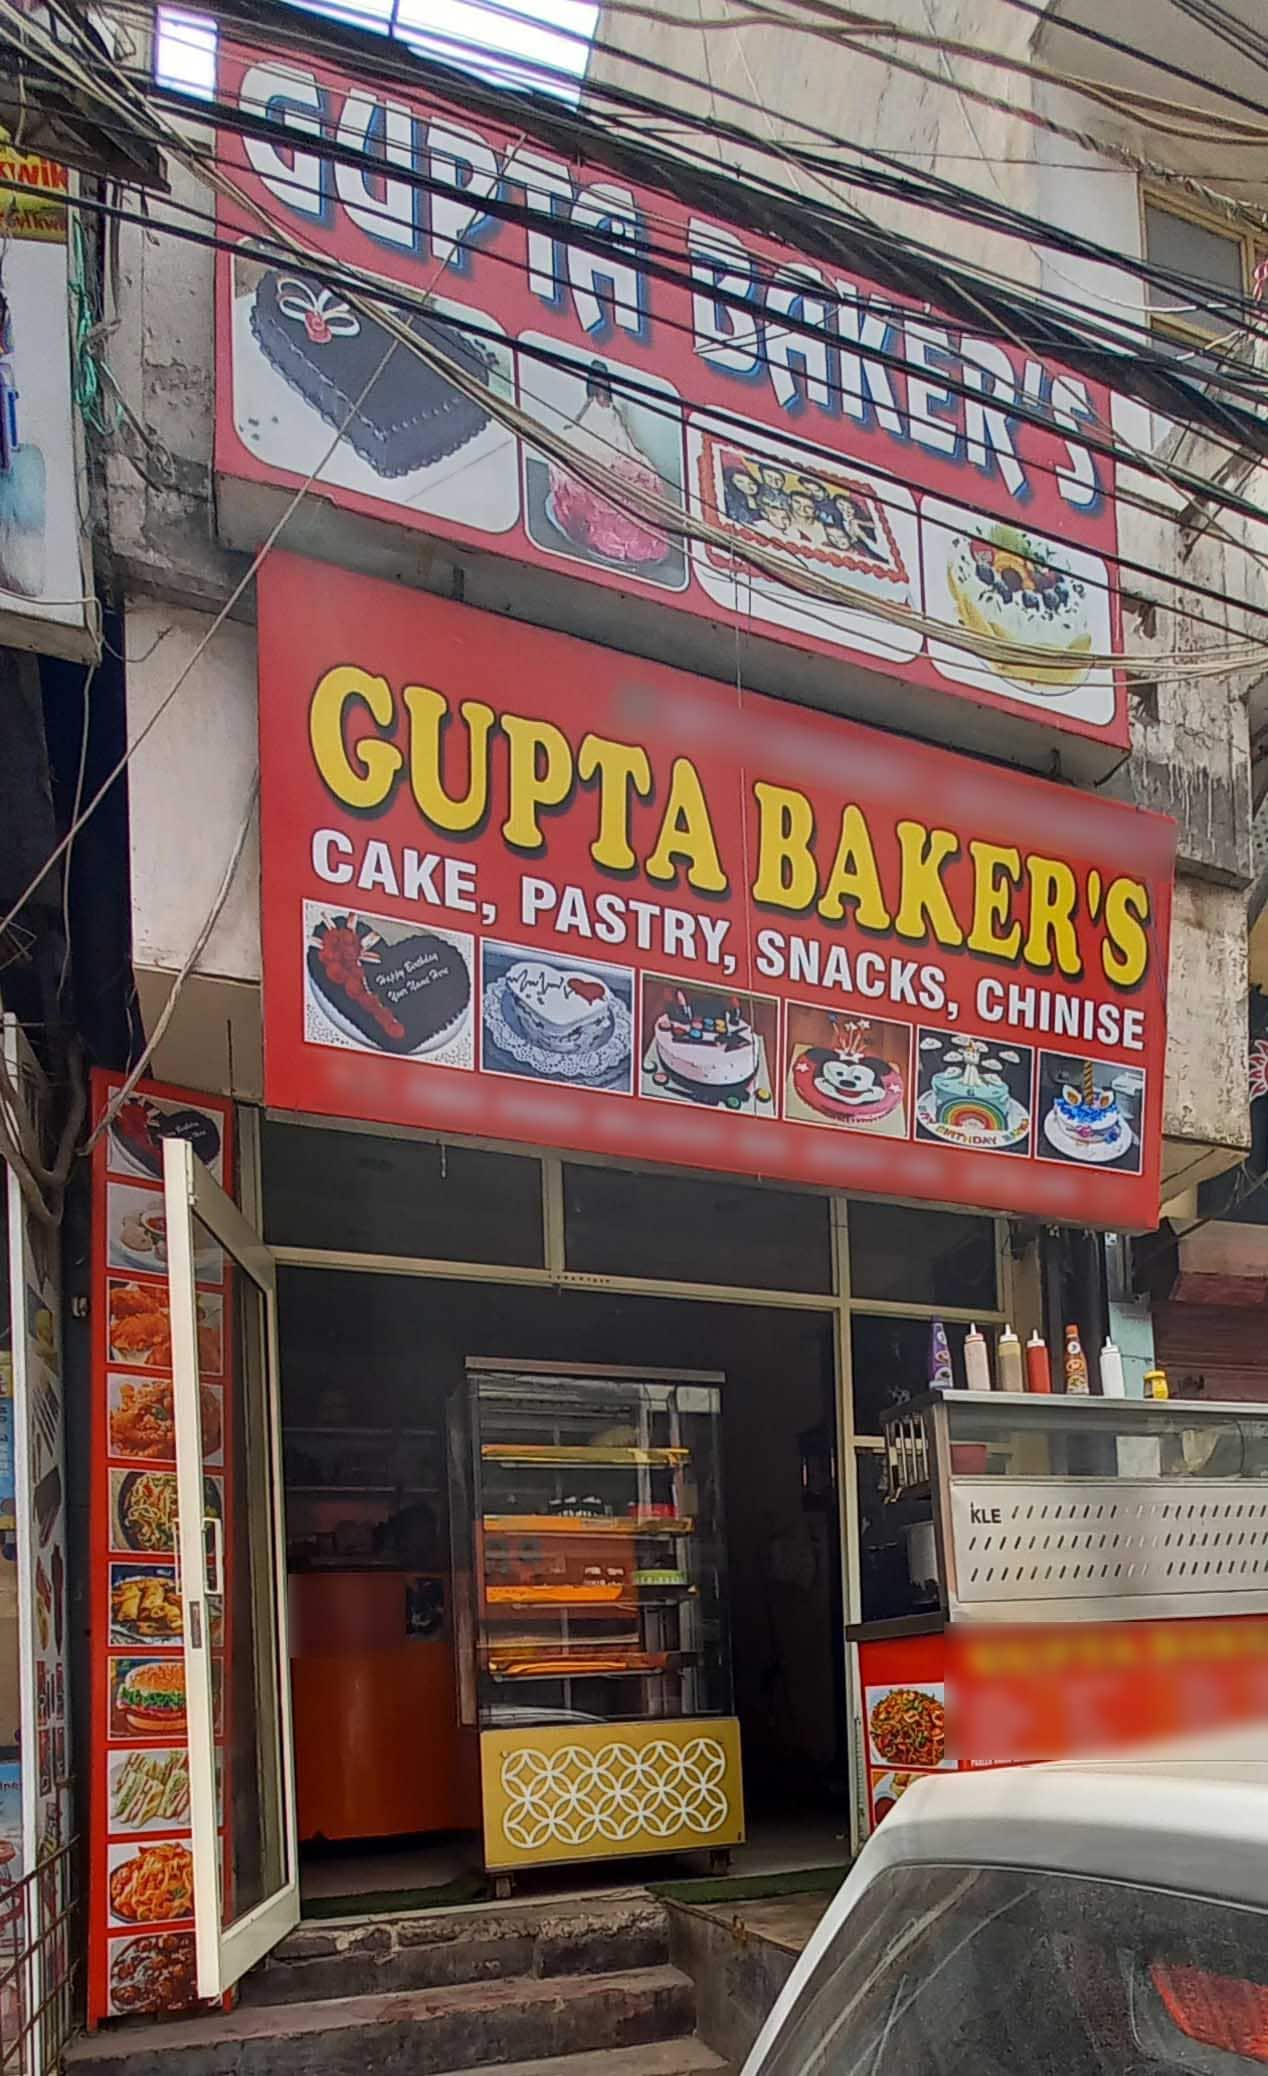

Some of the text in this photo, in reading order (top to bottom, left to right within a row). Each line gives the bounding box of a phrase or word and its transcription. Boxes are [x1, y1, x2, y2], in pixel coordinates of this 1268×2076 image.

[239, 61, 1098, 506] GUPTA BAKER'S
[309, 665, 1150, 987] GUPTA BAKER'S
[311, 828, 1146, 1051] CAKE, PASTRY, SNACKS, CHINISE
[970, 1501, 1002, 1524] KLE
